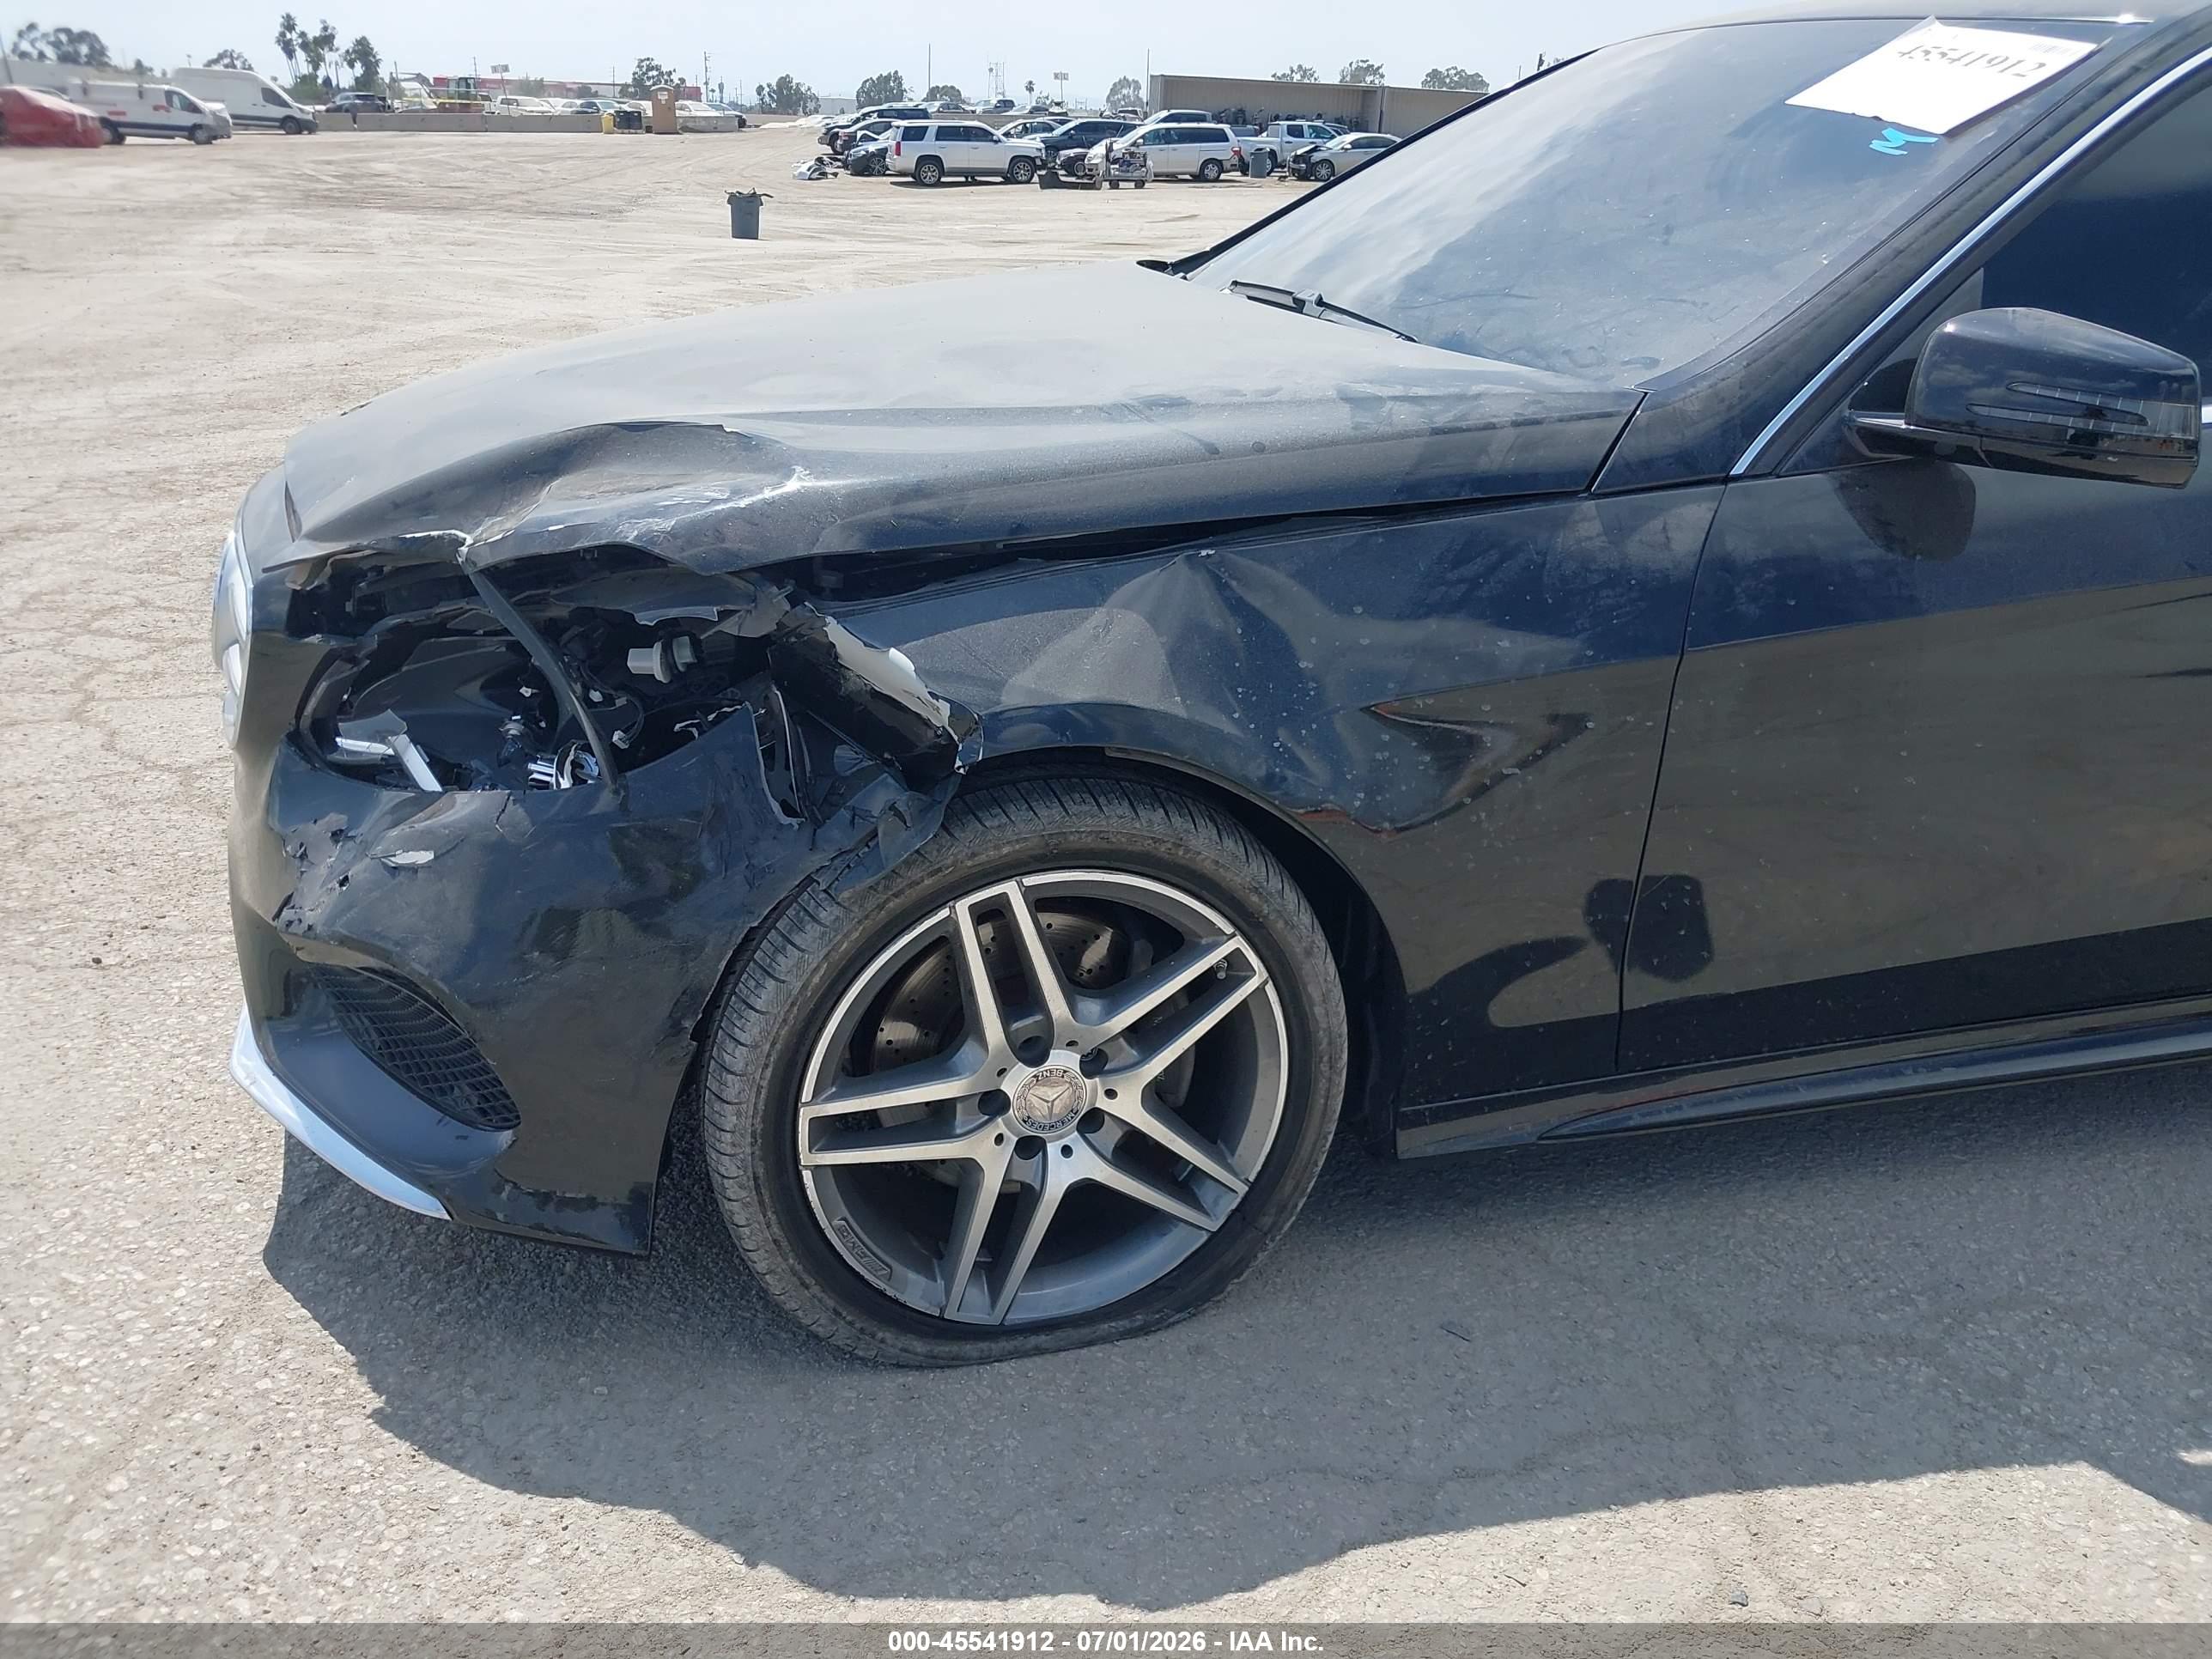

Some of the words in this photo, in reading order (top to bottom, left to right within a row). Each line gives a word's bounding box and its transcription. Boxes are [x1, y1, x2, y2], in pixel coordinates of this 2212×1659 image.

[1898, 45, 2046, 77] 45541912
[1036, 1069, 1064, 1079] BENZ
[1026, 1112, 1075, 1131] MERCEDES
